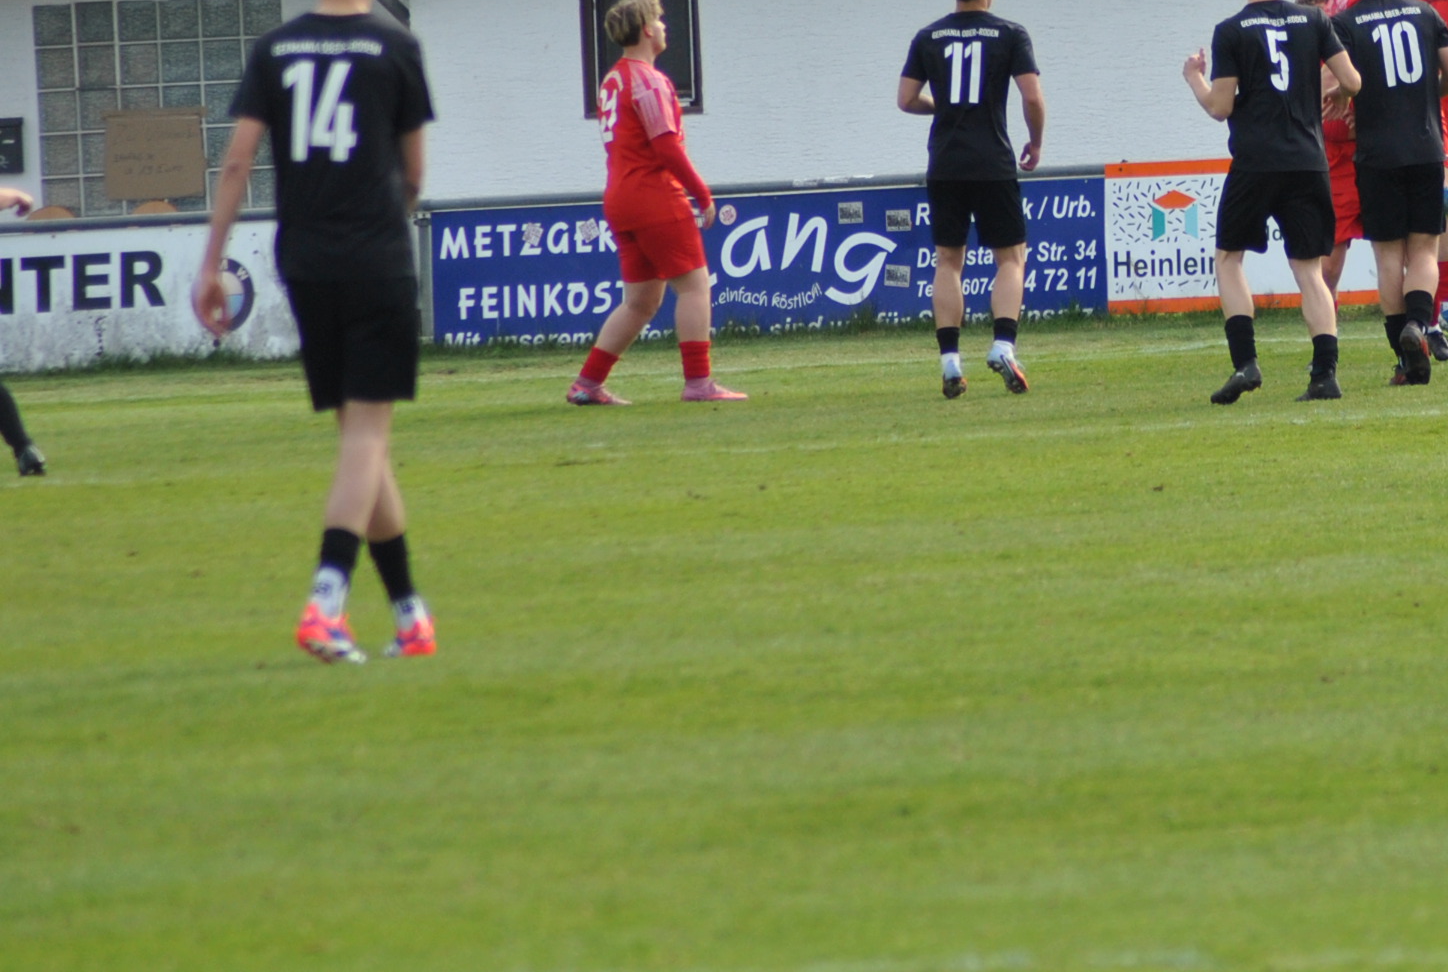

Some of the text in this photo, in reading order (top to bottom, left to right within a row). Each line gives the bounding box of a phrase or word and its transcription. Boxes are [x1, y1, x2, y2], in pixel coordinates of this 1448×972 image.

[944, 40, 982, 104] 11
[1265, 28, 1290, 92] 5
[1371, 20, 1423, 88] 10
[281, 59, 358, 162] 14
[1052, 194, 1097, 219] Urb.
[440, 220, 618, 260] METZGER
[711, 212, 898, 306] ang
[1036, 240, 1068, 263] Str.
[1074, 239, 1097, 261] 34
[0, 250, 166, 315] TER
[961, 277, 996, 296] 6074
[1043, 268, 1069, 292] 72
[1075, 267, 1098, 290] 11
